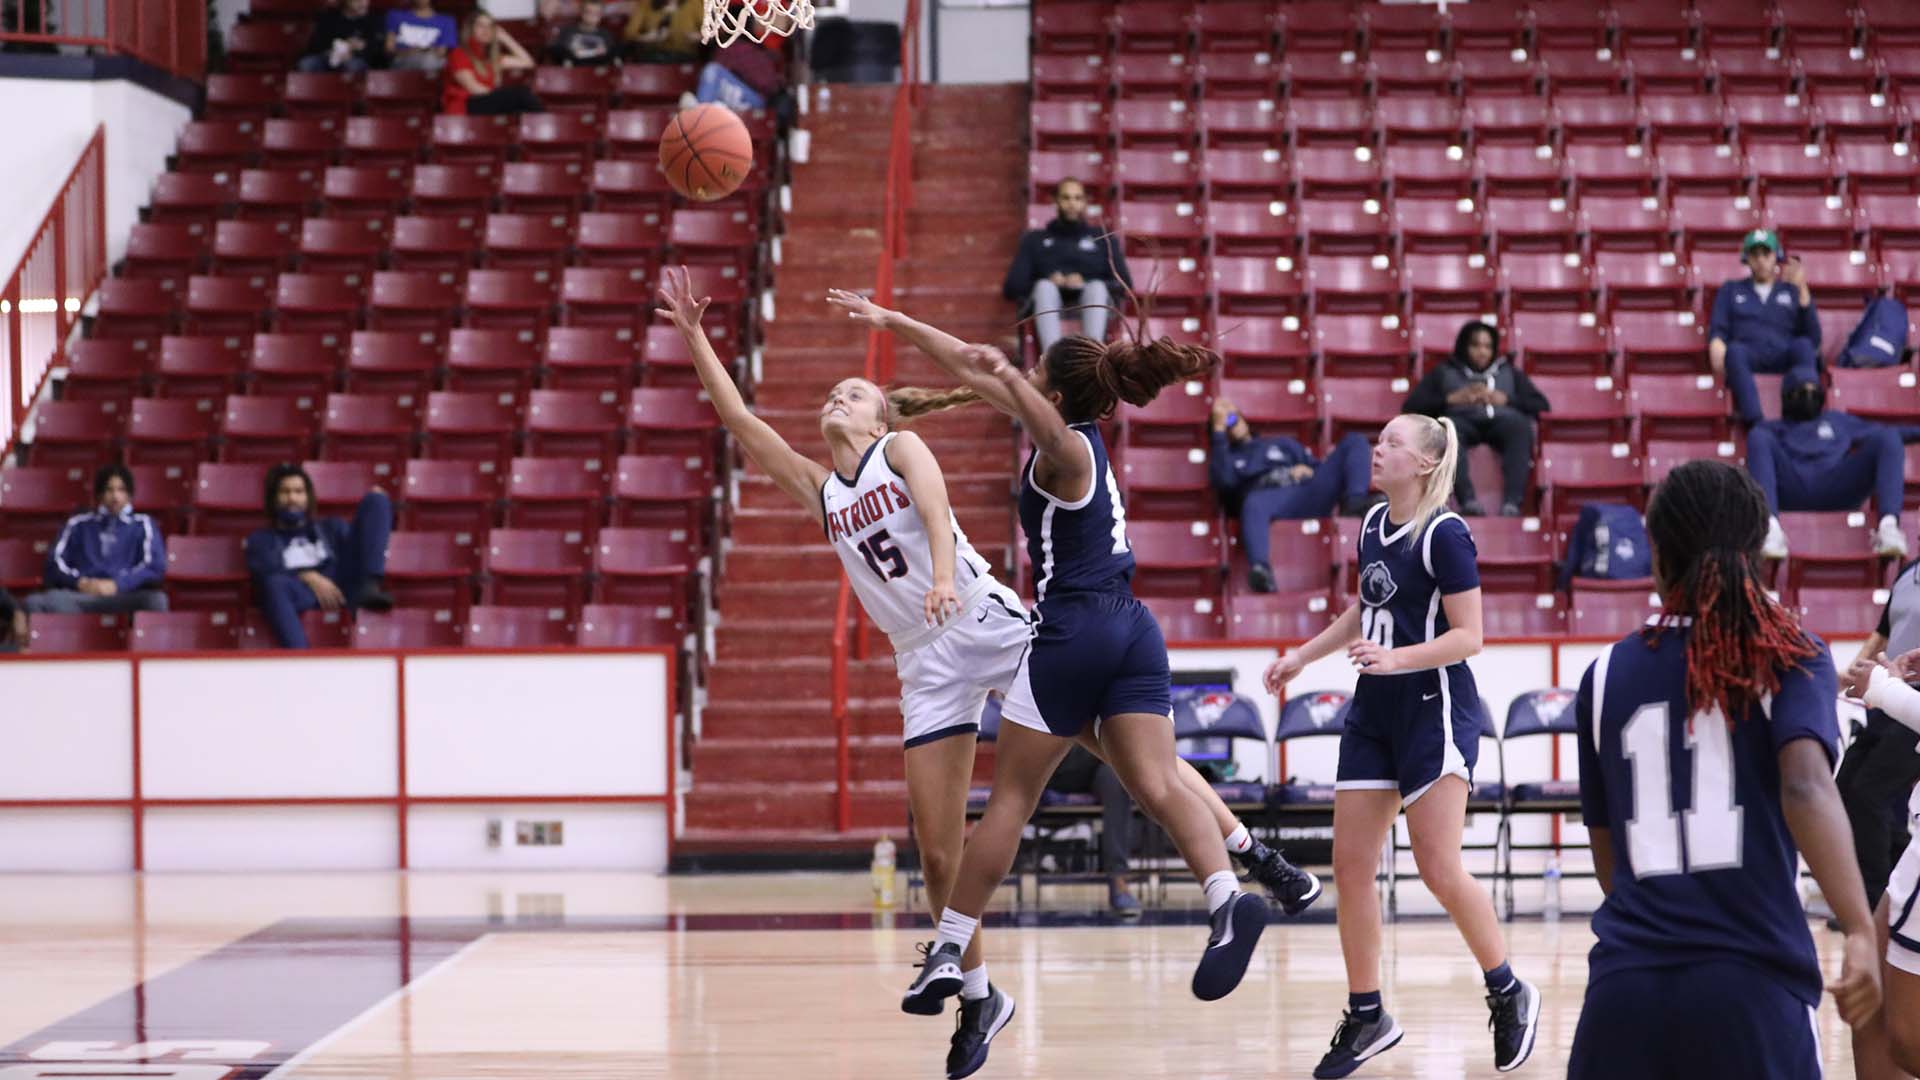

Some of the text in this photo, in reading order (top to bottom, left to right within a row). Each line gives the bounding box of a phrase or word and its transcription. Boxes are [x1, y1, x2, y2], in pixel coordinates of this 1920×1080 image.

[827, 481, 911, 543] ATRIOTS
[857, 527, 909, 584] 15
[1620, 699, 1744, 882] 11
